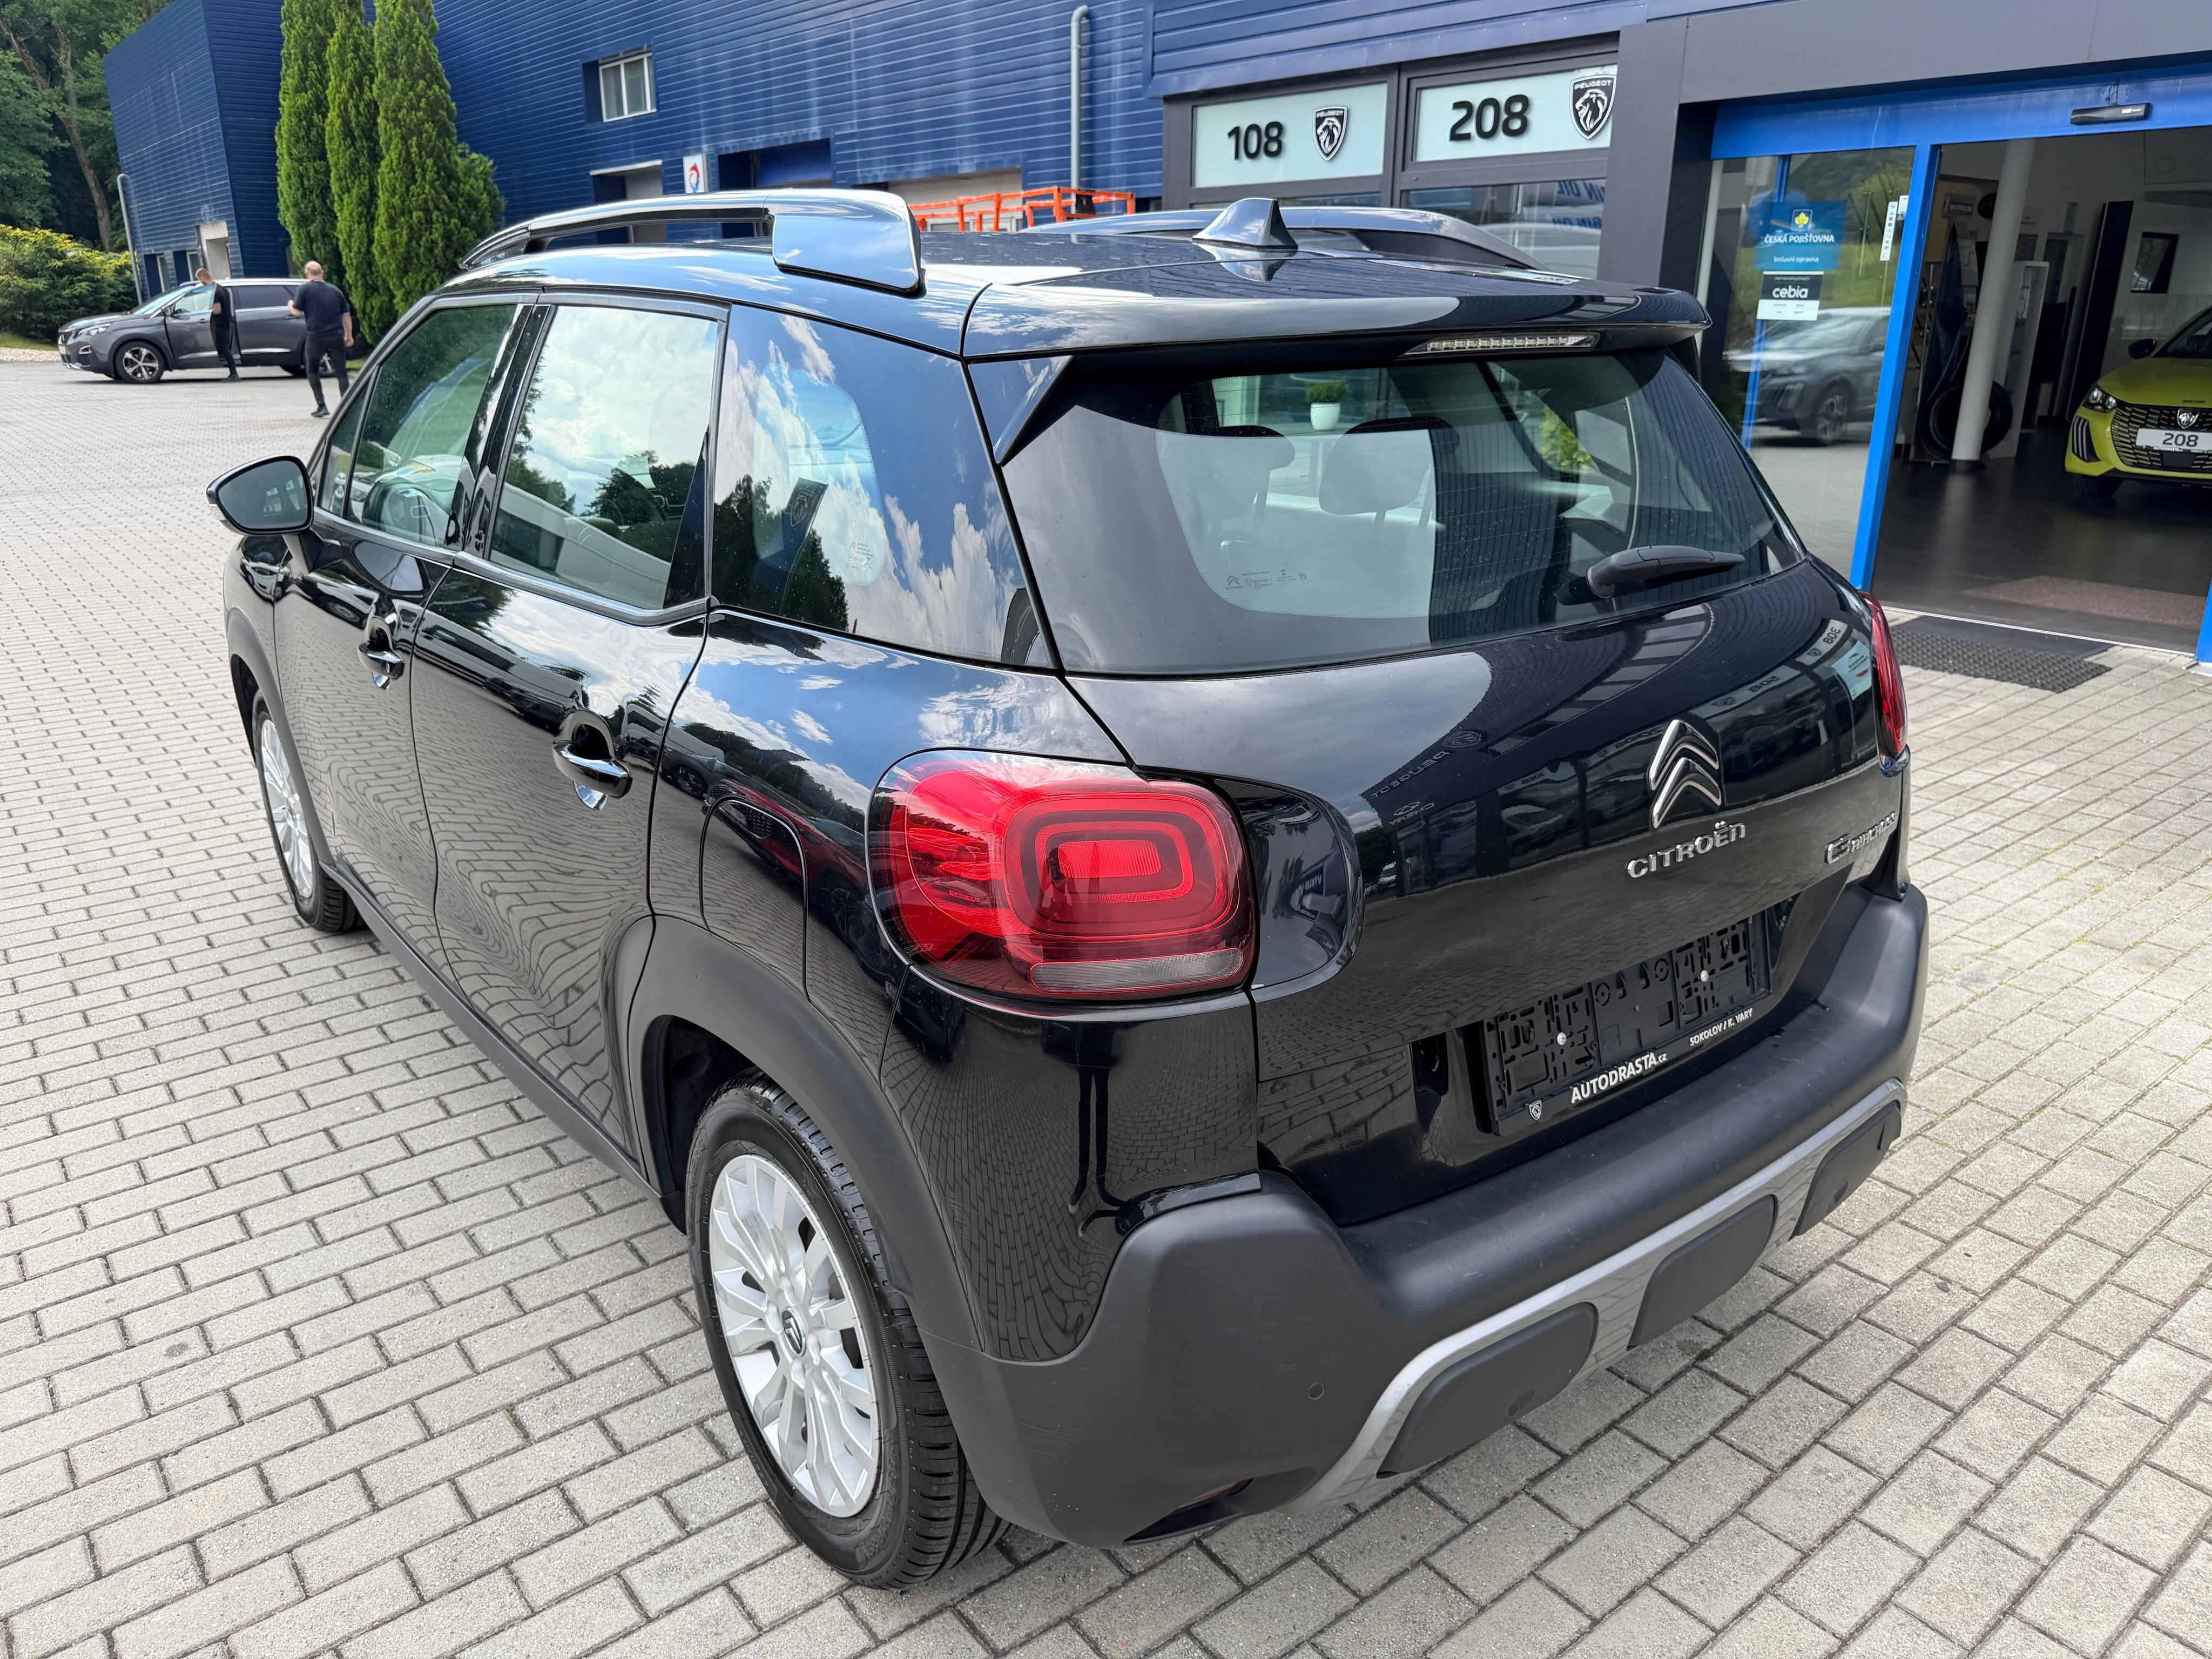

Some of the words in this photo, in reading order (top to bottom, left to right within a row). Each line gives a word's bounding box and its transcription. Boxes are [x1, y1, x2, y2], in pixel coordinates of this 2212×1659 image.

[1574, 79, 1613, 90] PEUGEOT
[1449, 95, 1528, 141] 208
[1228, 121, 1283, 160] 108
[1764, 233, 1787, 243] ČESKÁ
[1789, 233, 1835, 244] POJIŠŤOVNA
[1772, 285, 1809, 298] cebia
[2162, 433, 2198, 447] 208
[1627, 820, 1746, 879] CITROËN
[1825, 834, 1852, 864] C3
[1689, 1022, 1723, 1047] SOKOLOV
[1728, 1018, 1735, 1028] K.
[1735, 1008, 1752, 1023] VARY
[1570, 1051, 1668, 1104] AUTODRASTA.cz
